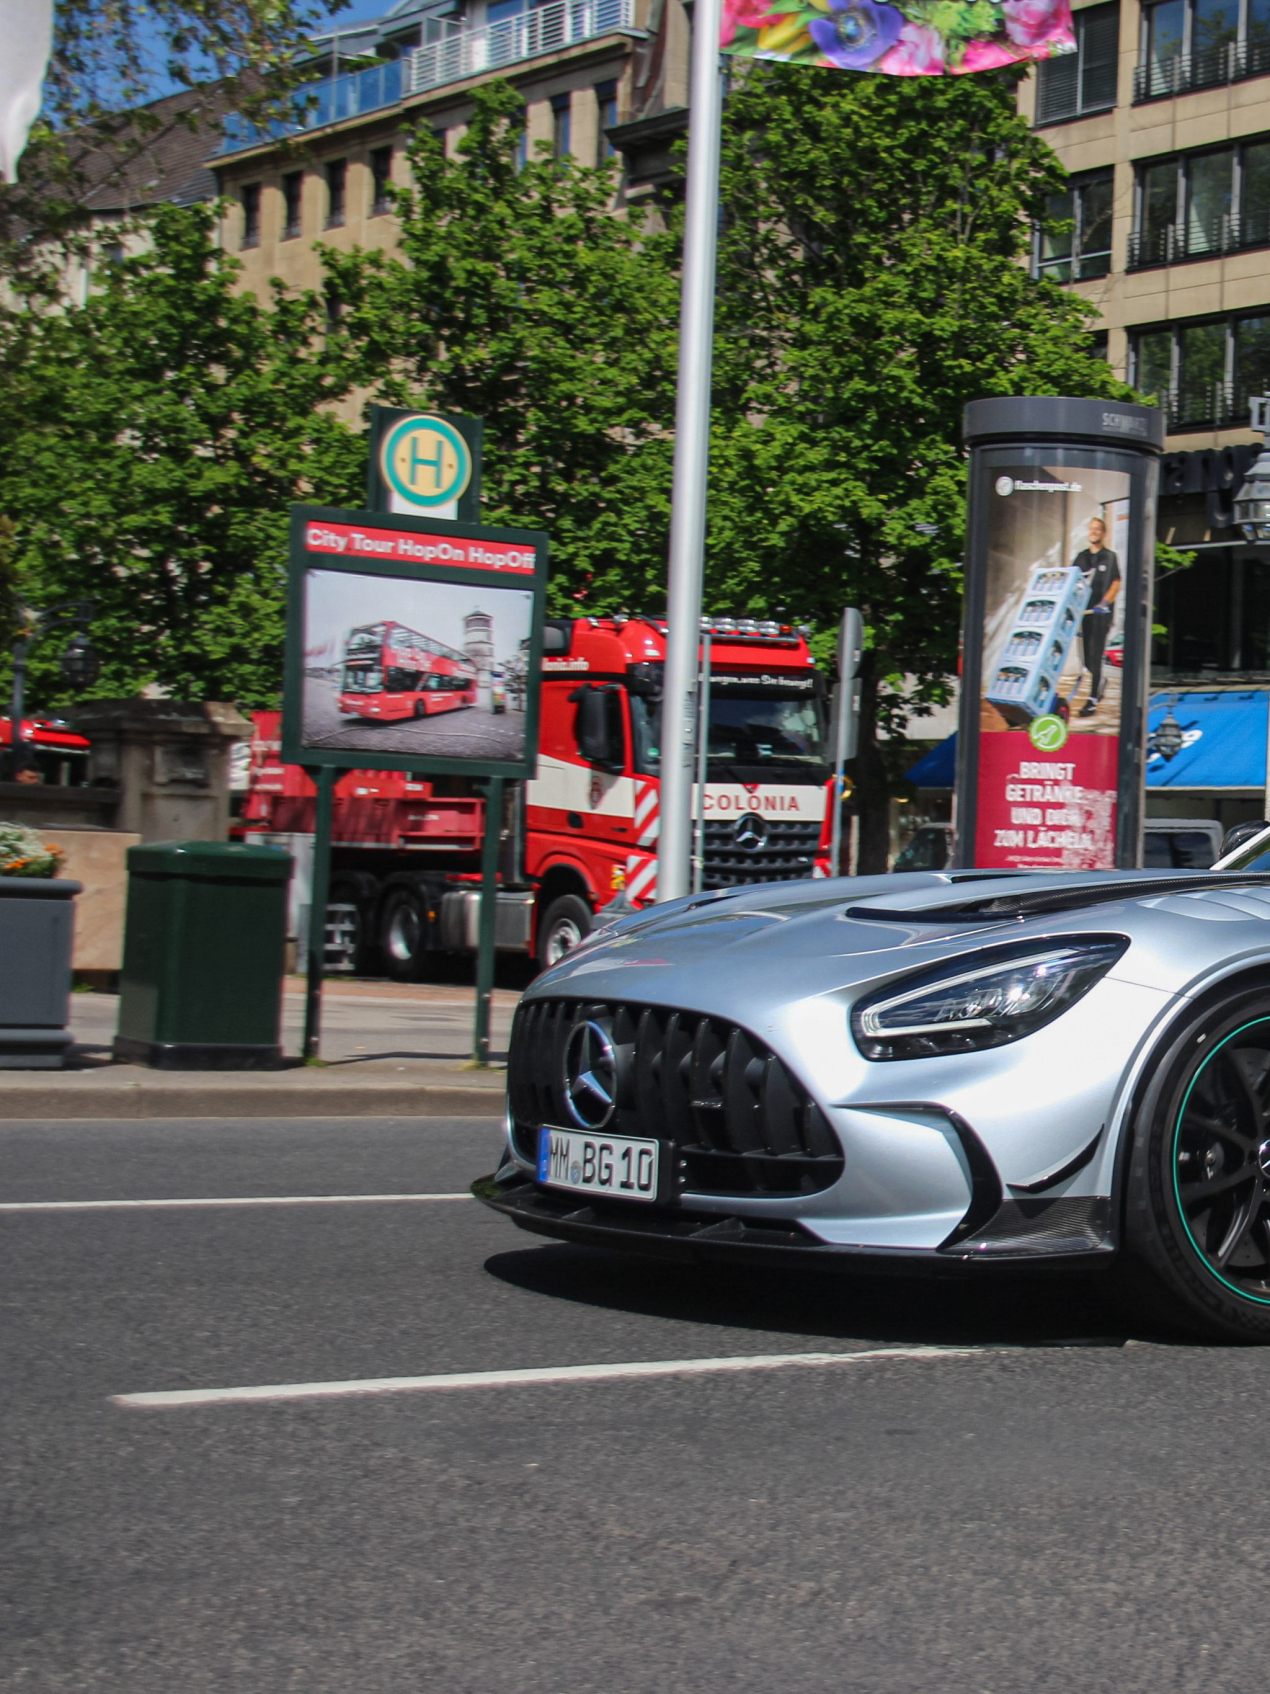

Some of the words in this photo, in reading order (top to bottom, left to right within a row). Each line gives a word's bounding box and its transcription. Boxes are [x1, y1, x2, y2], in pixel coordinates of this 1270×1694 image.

[408, 436, 443, 489] H
[307, 529, 348, 552] City
[351, 533, 395, 553] Tour
[397, 539, 465, 560] HopOn
[468, 546, 536, 569] HopOff
[1020, 762, 1076, 780] BRINGT
[703, 794, 800, 811] COLONIA
[582, 1140, 615, 1187] BG
[620, 1146, 654, 1192] 10
